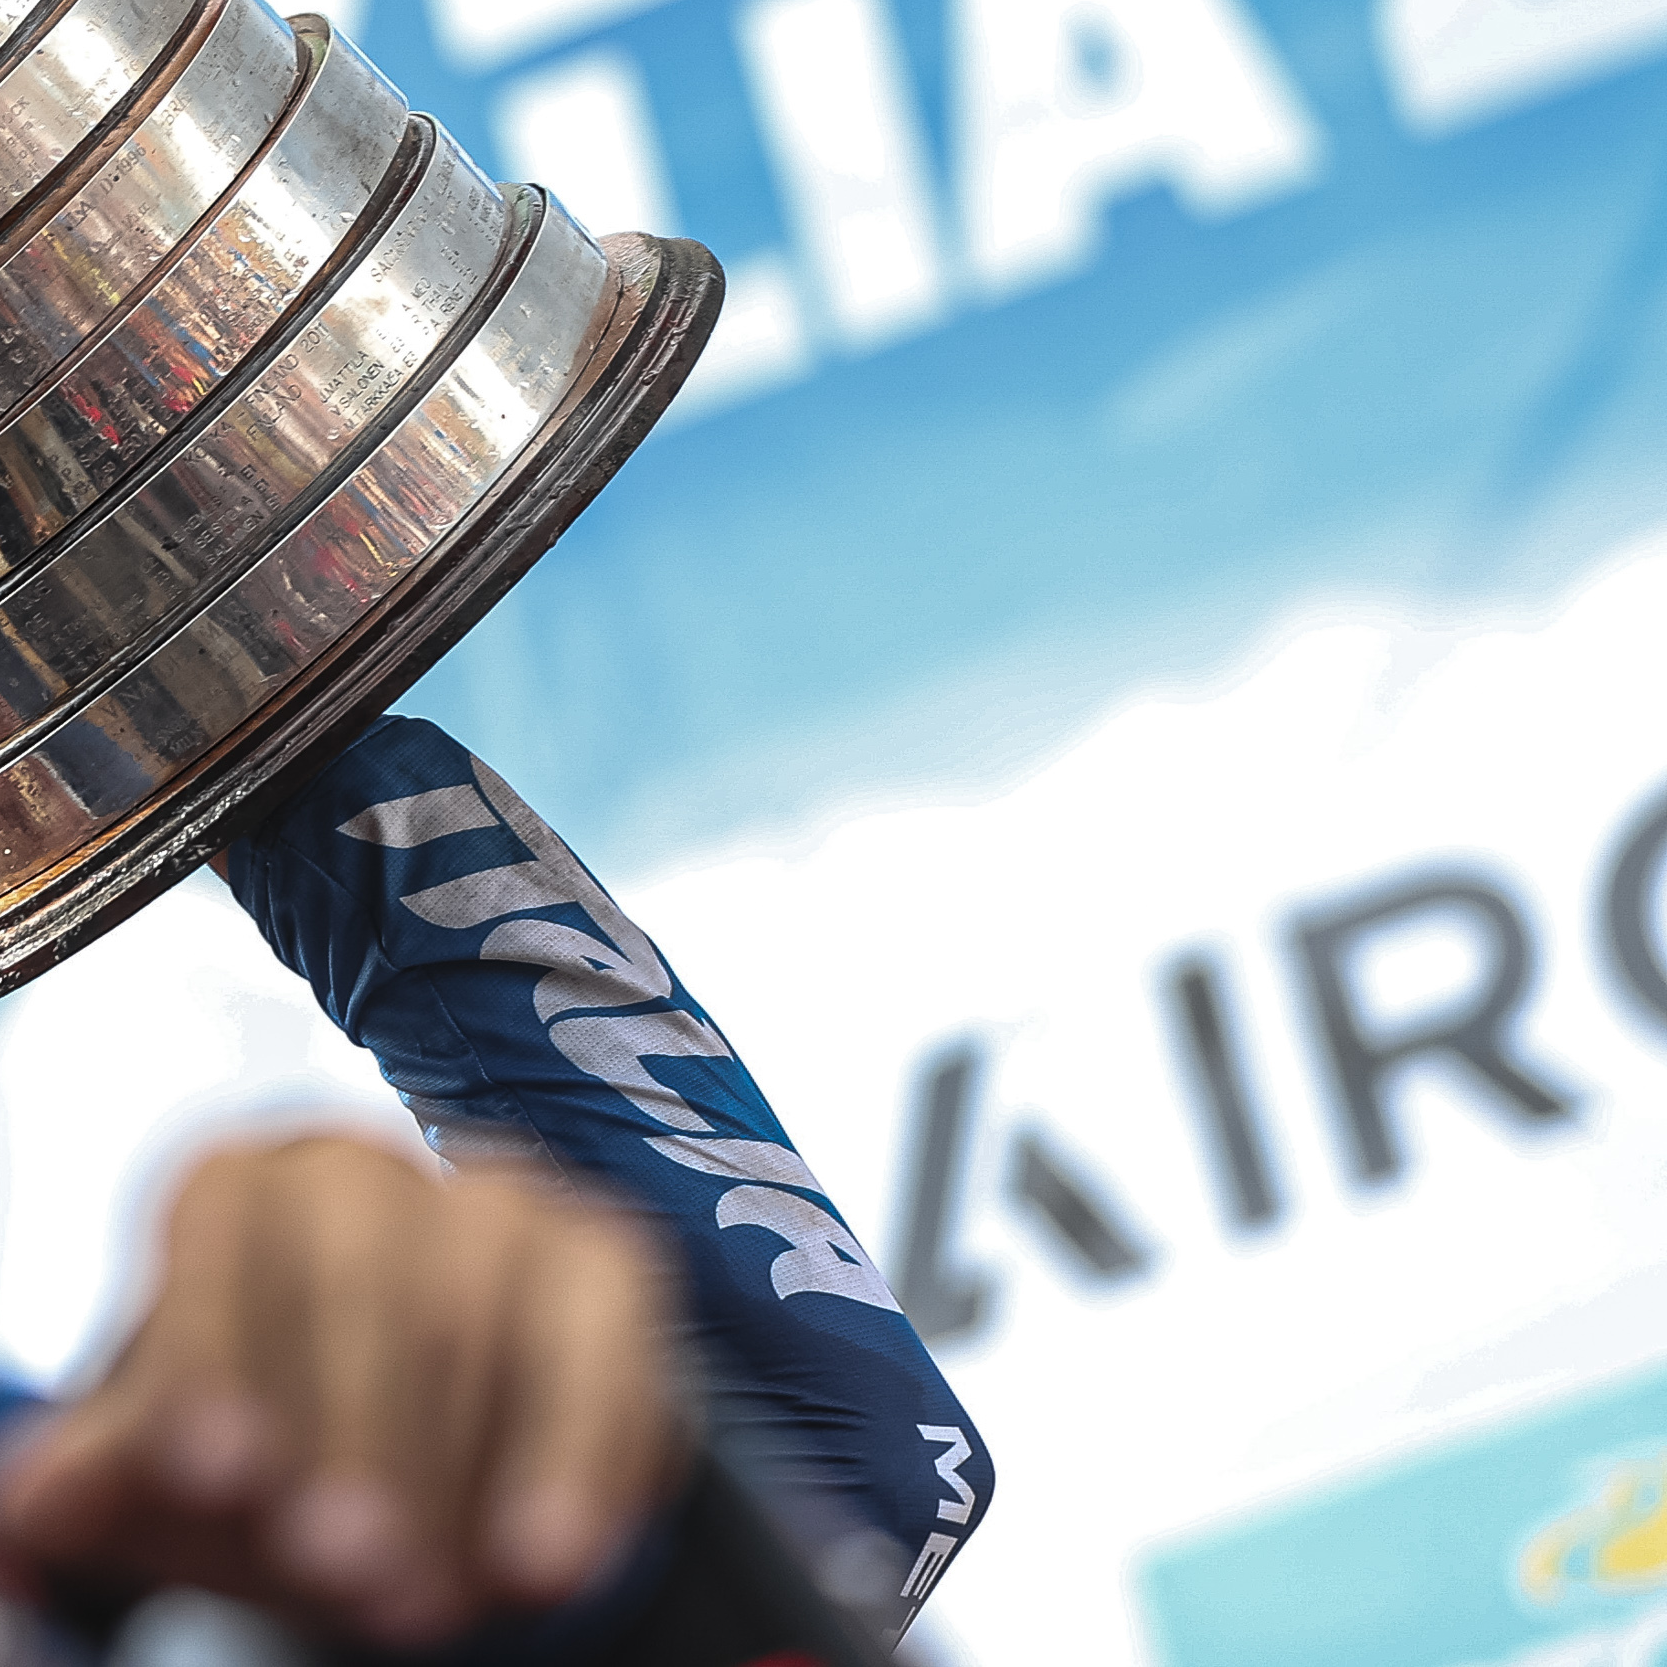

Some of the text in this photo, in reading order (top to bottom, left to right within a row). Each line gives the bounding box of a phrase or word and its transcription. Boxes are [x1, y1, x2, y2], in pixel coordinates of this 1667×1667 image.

[242, 348, 302, 413] FINLAND
[244, 379, 306, 445] FINLAND
[335, 751, 904, 1314] ITALIA
[882, 769, 1667, 1359] AIR
[880, 1421, 977, 1656] ME
